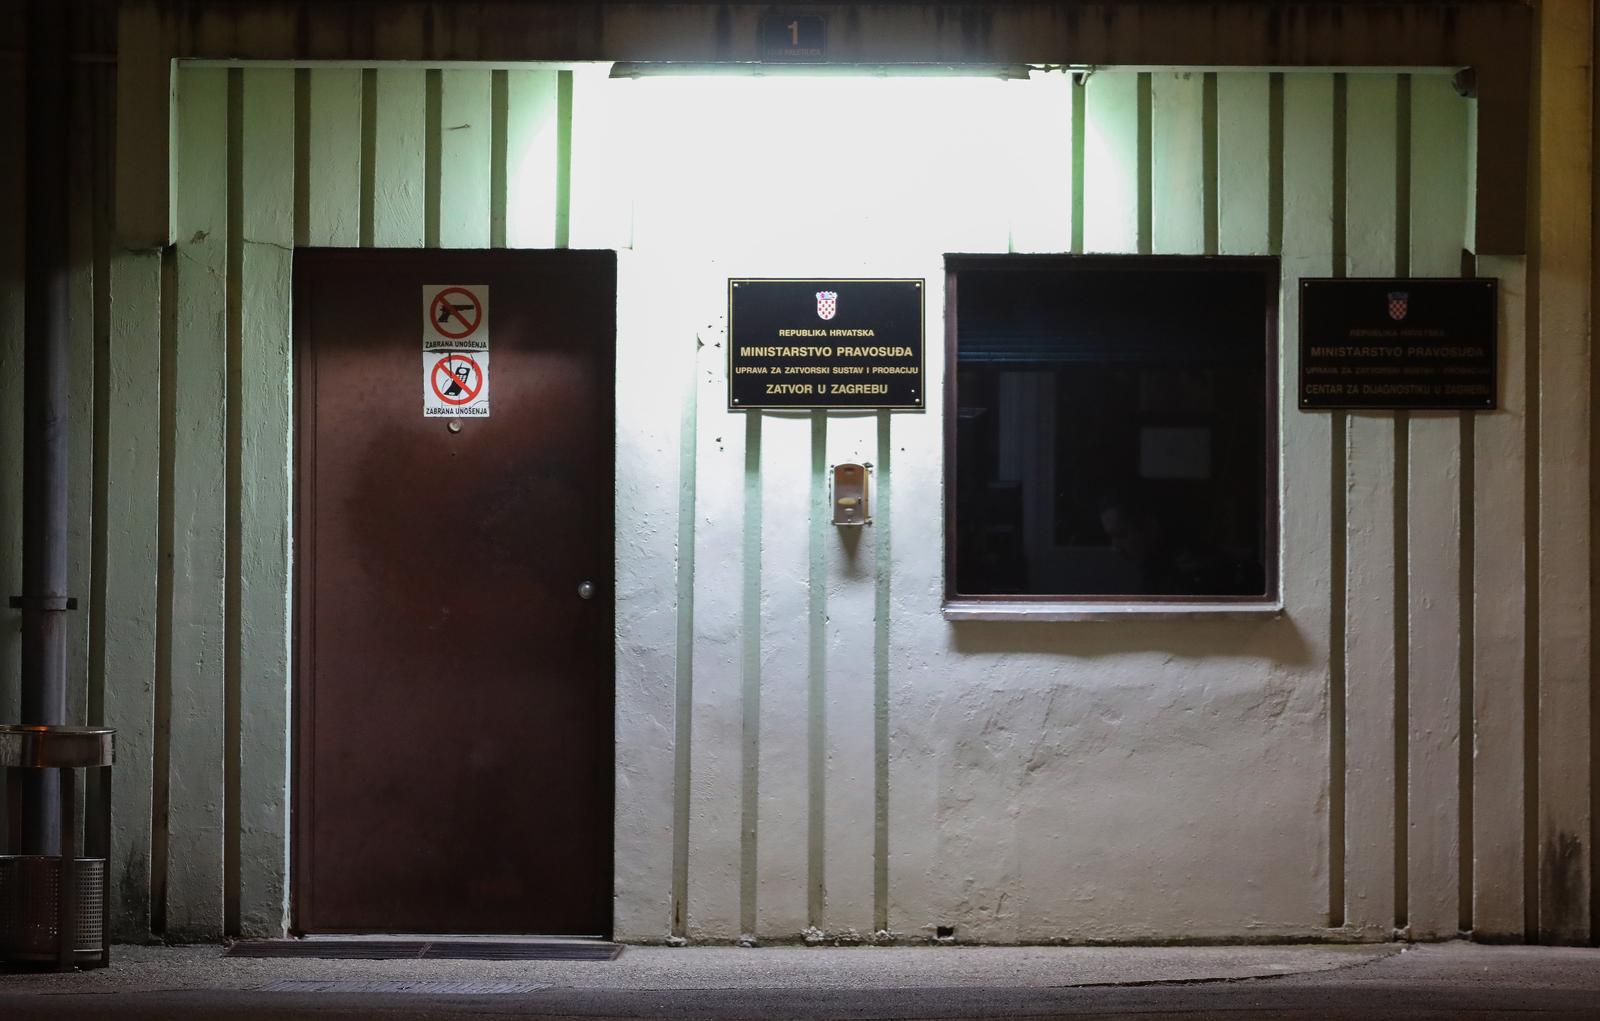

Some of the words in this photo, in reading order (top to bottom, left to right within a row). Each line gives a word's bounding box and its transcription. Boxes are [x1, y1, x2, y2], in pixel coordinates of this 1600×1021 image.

[787, 20, 799, 46] 1
[778, 329, 827, 337] REPUBLIKA
[829, 329, 875, 337] HRVATSKA
[425, 341, 453, 349] ZABRANA
[455, 340, 487, 349] UNOŠENJA
[740, 346, 833, 357] MINISTARSTVO
[836, 346, 913, 357] PRAVOSUĐA
[1310, 347, 1403, 357] MINISTARSTVO
[735, 366, 768, 375] UPRAVA
[770, 366, 782, 375] ZA
[784, 366, 830, 375] ZATVORSKI
[832, 366, 864, 375] SUSTAV
[872, 366, 919, 375] PROBACIJU
[766, 384, 813, 394] ZATVOR
[817, 384, 827, 394] U
[831, 384, 888, 394] ZAGREBU
[1305, 384, 1343, 394] CENTAR
[1346, 384, 1360, 394] ZA
[1363, 384, 1431, 394] DIJAGNOSTIKU
[1434, 384, 1442, 394] U
[425, 407, 454, 415] ZABRANA
[455, 406, 488, 415] UNOŠENJA
